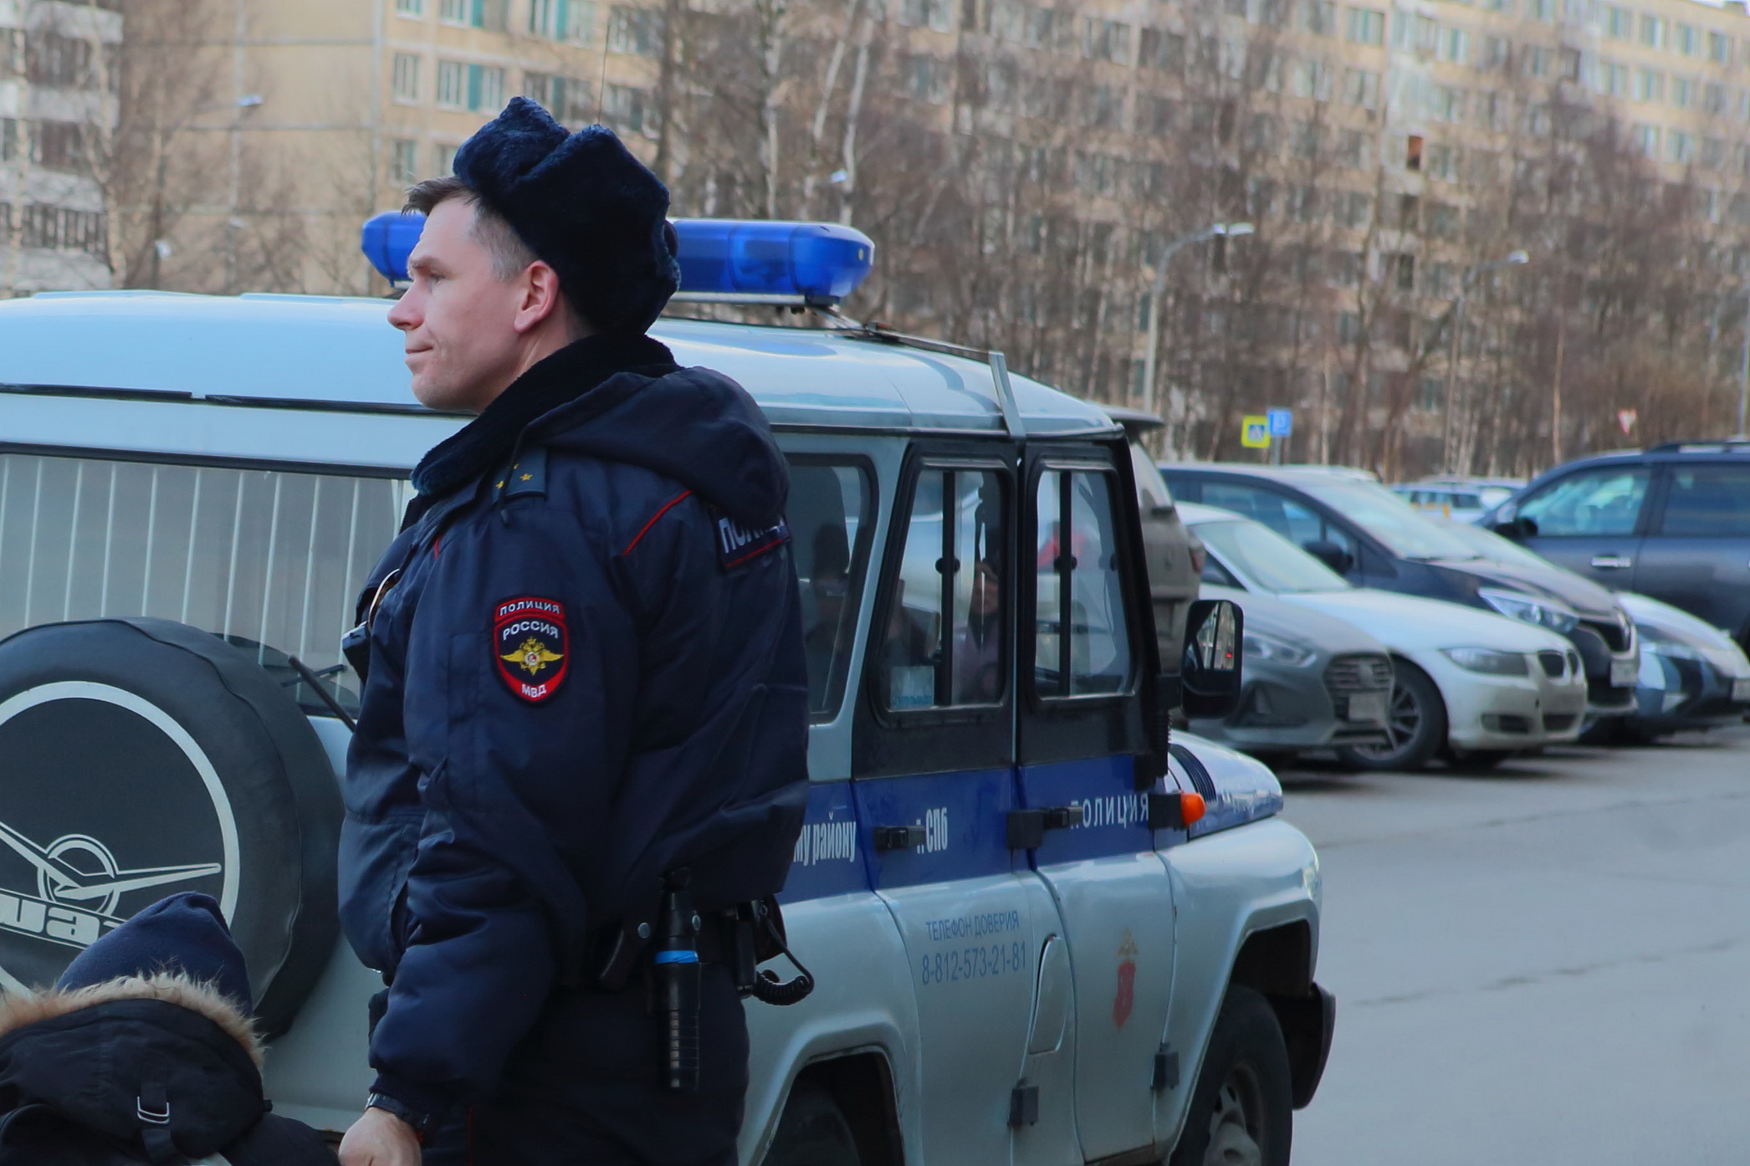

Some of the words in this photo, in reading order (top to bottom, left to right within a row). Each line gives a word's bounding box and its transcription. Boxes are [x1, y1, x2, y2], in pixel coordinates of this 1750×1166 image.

[499, 600, 560, 617] ПОЛИЦИЯ
[502, 620, 559, 641] РОССИЯ
[521, 683, 547, 698] МВД
[812, 811, 857, 866] району
[925, 917, 972, 942] ТЕЛЕФОН
[974, 909, 1020, 938] ДОВЕРИЯ
[922, 941, 1026, 985] 8-812-573-21-81
